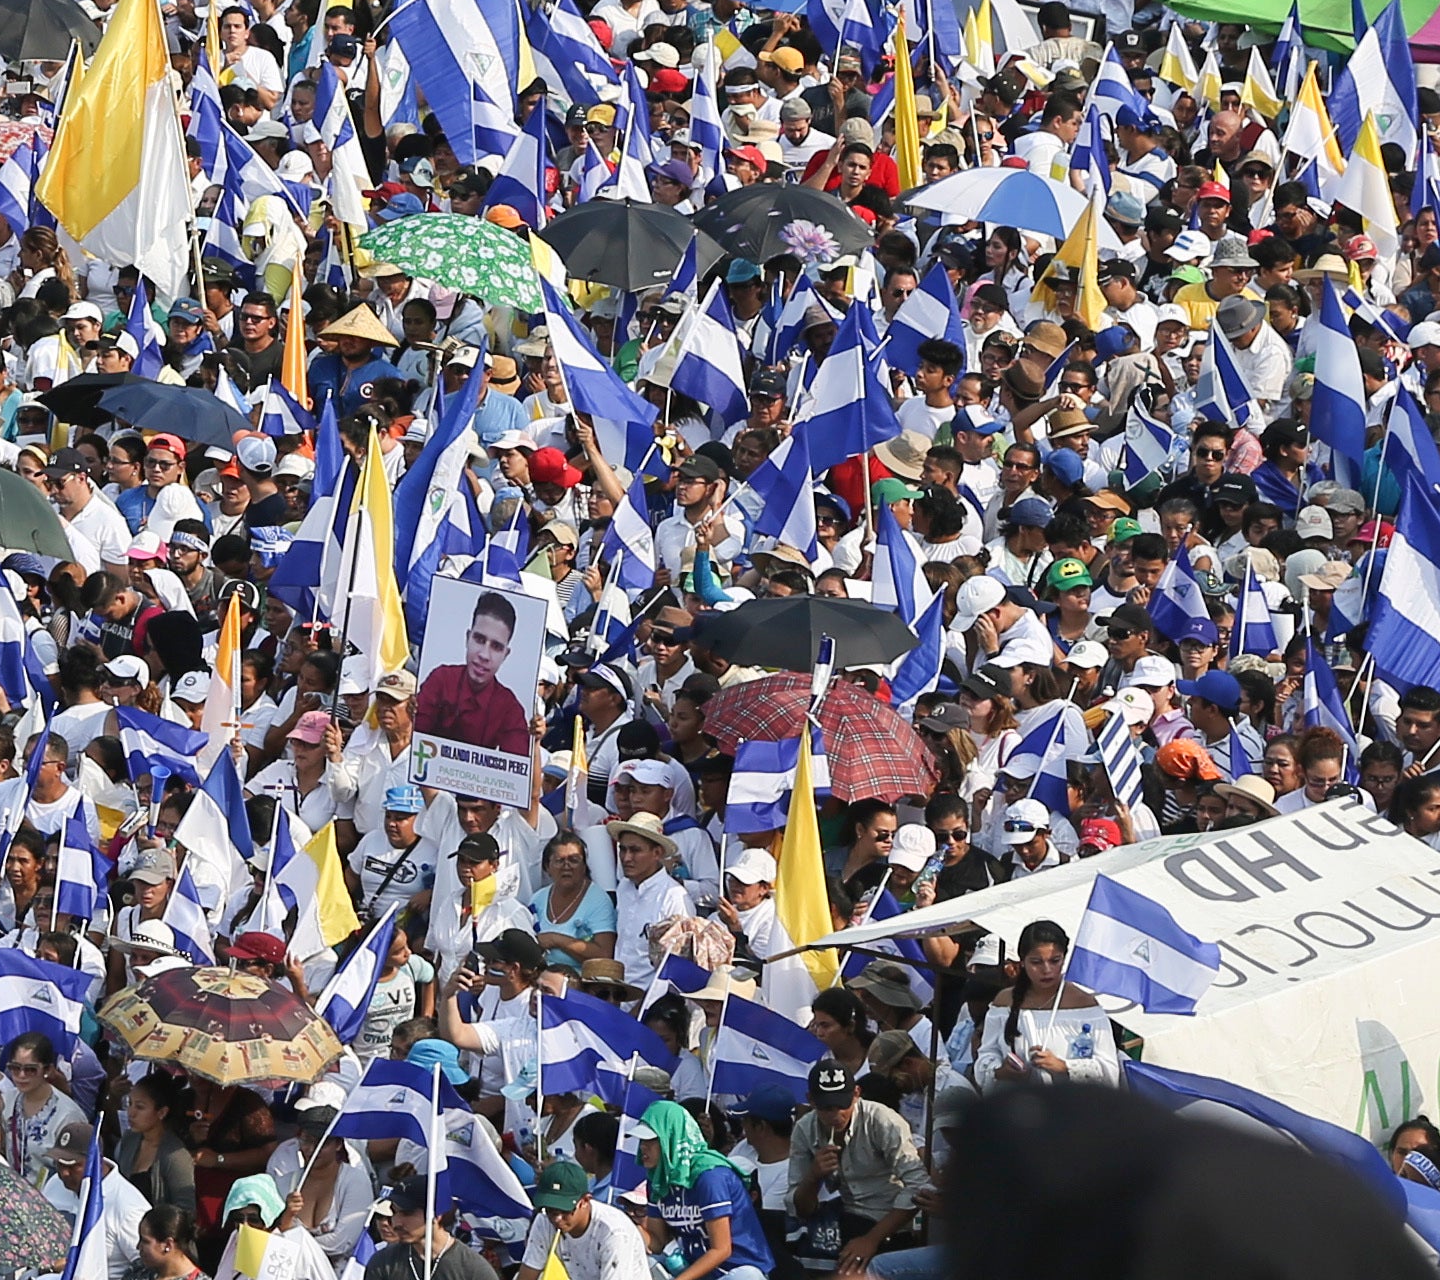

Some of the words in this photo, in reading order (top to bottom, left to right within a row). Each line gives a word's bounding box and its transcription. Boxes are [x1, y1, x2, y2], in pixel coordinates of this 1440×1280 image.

[440, 744, 471, 764] ORLANDO
[470, 751, 507, 771] FRANCISCO
[438, 765, 481, 783] PASTORAL
[482, 775, 517, 791] JUVENIL
[475, 784, 489, 795] DE
[1163, 830, 1322, 904] HD
